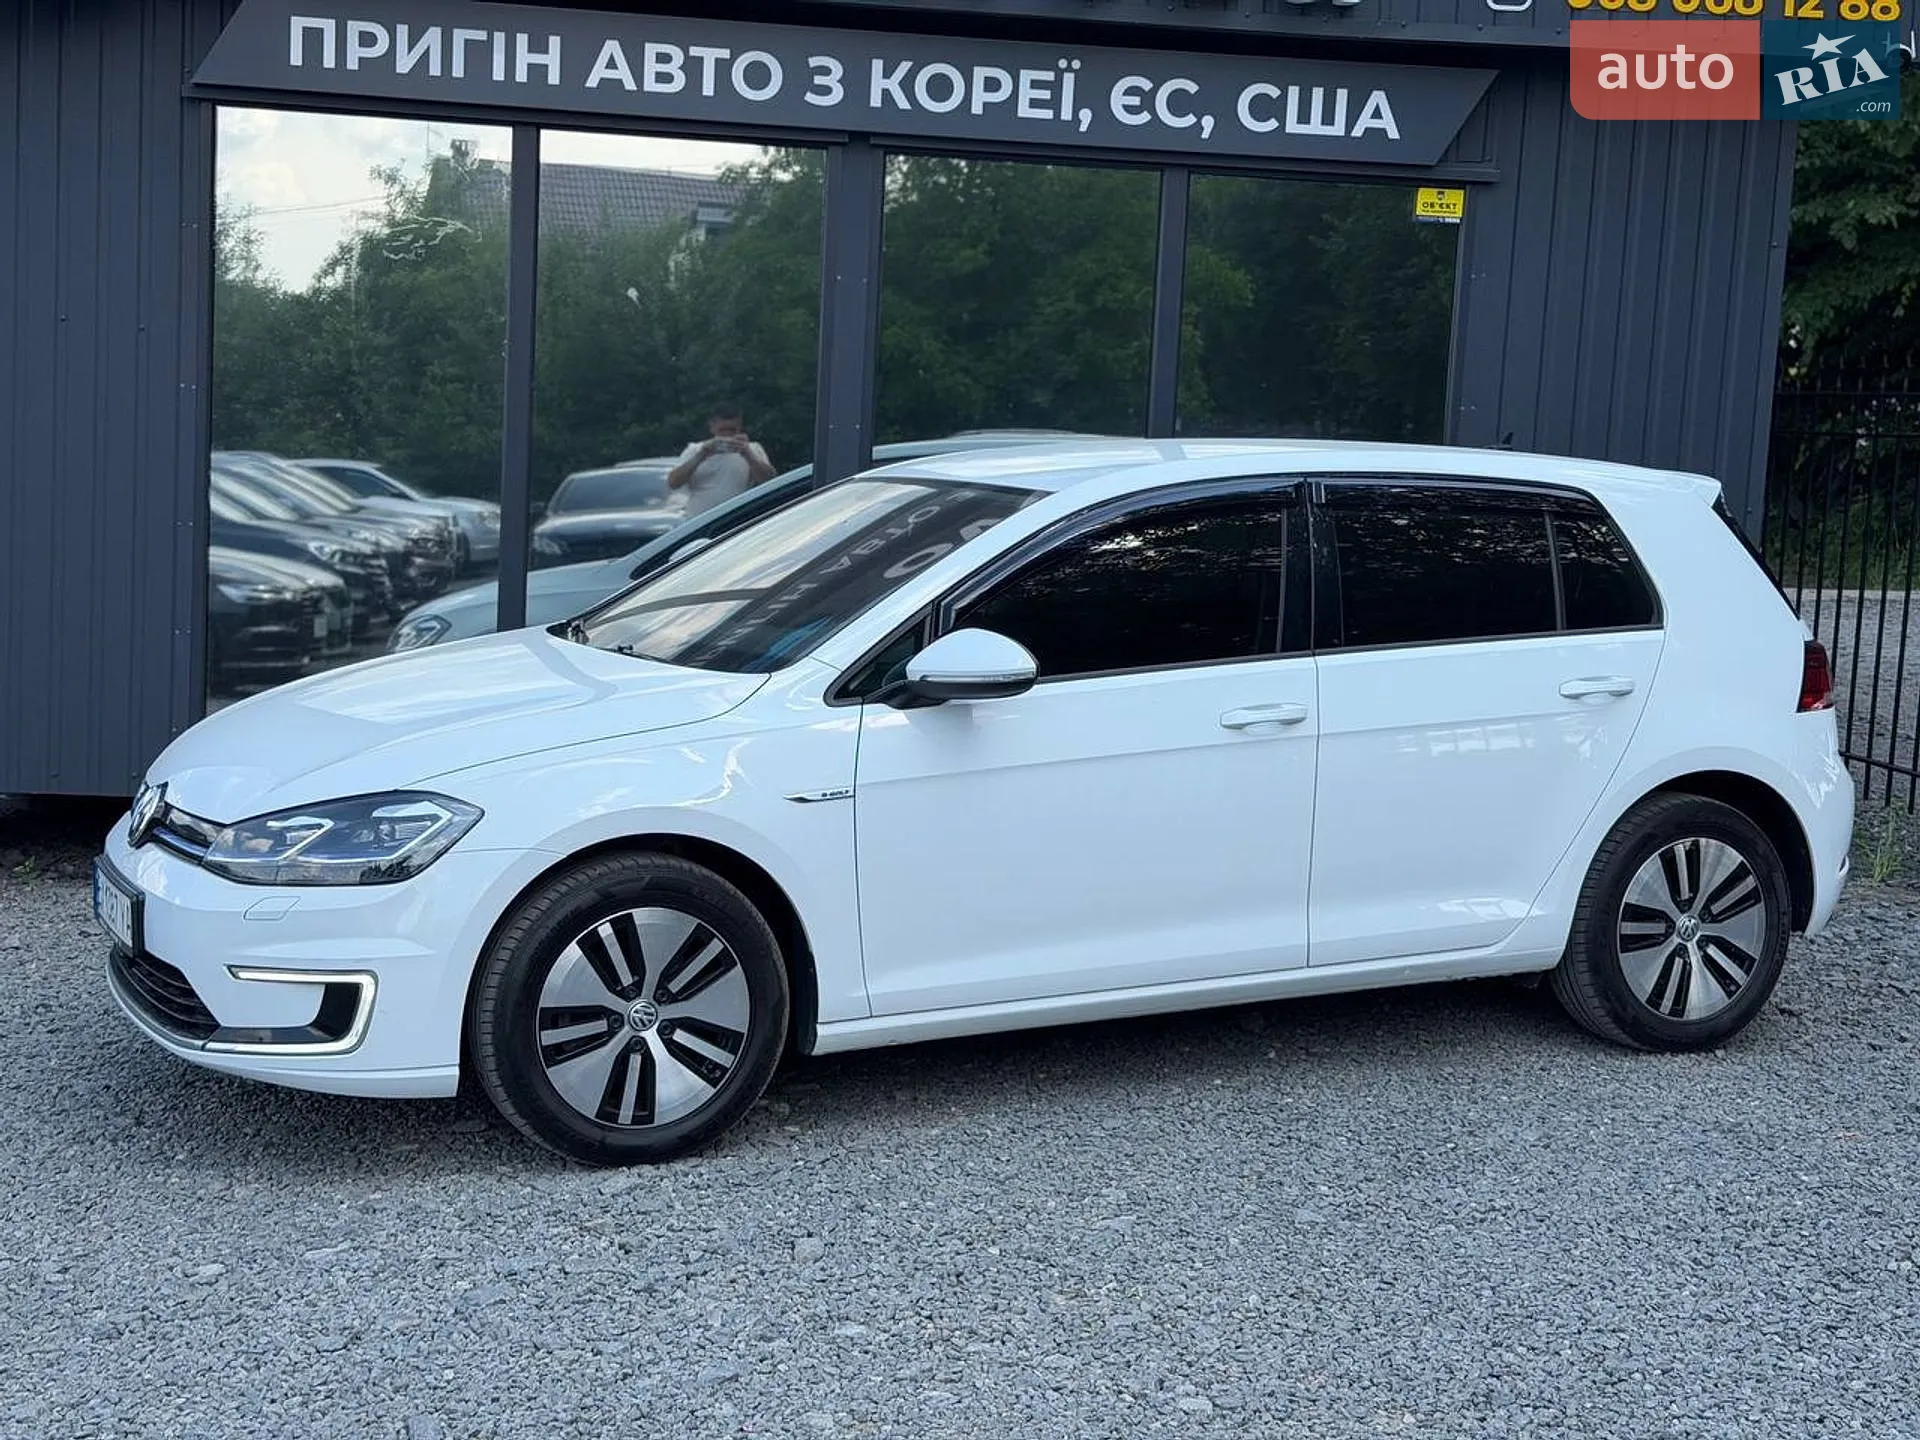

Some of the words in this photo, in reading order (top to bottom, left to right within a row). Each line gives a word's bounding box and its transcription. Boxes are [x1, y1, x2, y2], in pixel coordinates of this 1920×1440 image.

[289, 15, 561, 86] ПРИГІН
[584, 39, 783, 101] АВТО
[803, 55, 845, 107] З
[869, 58, 1093, 132] КОРЕЇ,
[1110, 76, 1215, 139] ЄС,
[1237, 82, 1401, 140] США
